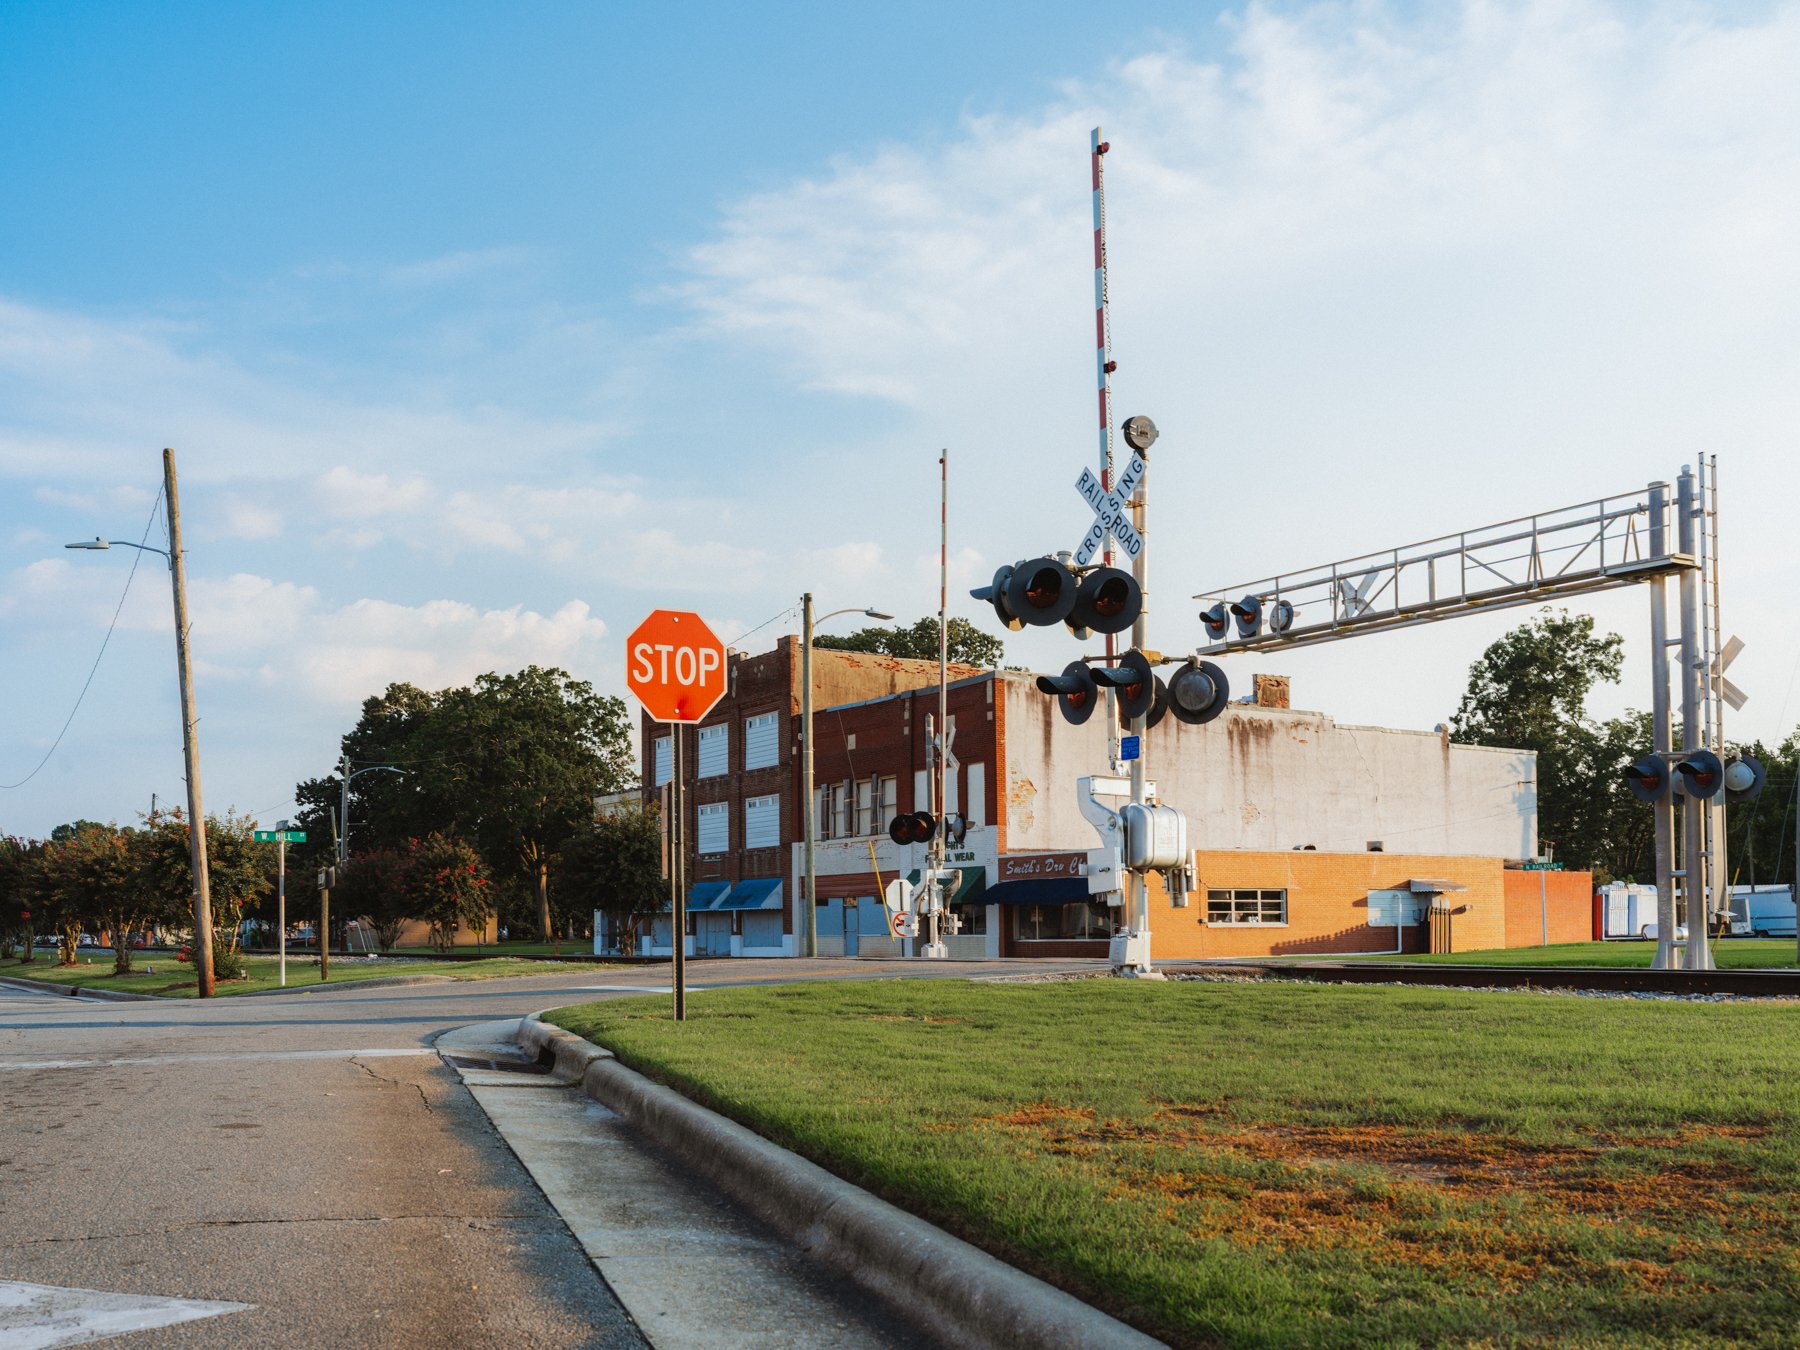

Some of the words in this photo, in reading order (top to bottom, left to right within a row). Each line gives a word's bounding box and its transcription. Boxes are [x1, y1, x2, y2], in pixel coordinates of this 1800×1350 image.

[1077, 459, 1143, 566] CROSSING
[1078, 472, 1141, 555] RAILROAD
[632, 643, 719, 687] STOP
[275, 832, 292, 841] HILL
[925, 853, 952, 863] FAL
[954, 852, 975, 862] WEAR
[1006, 860, 1040, 875] Smith's
